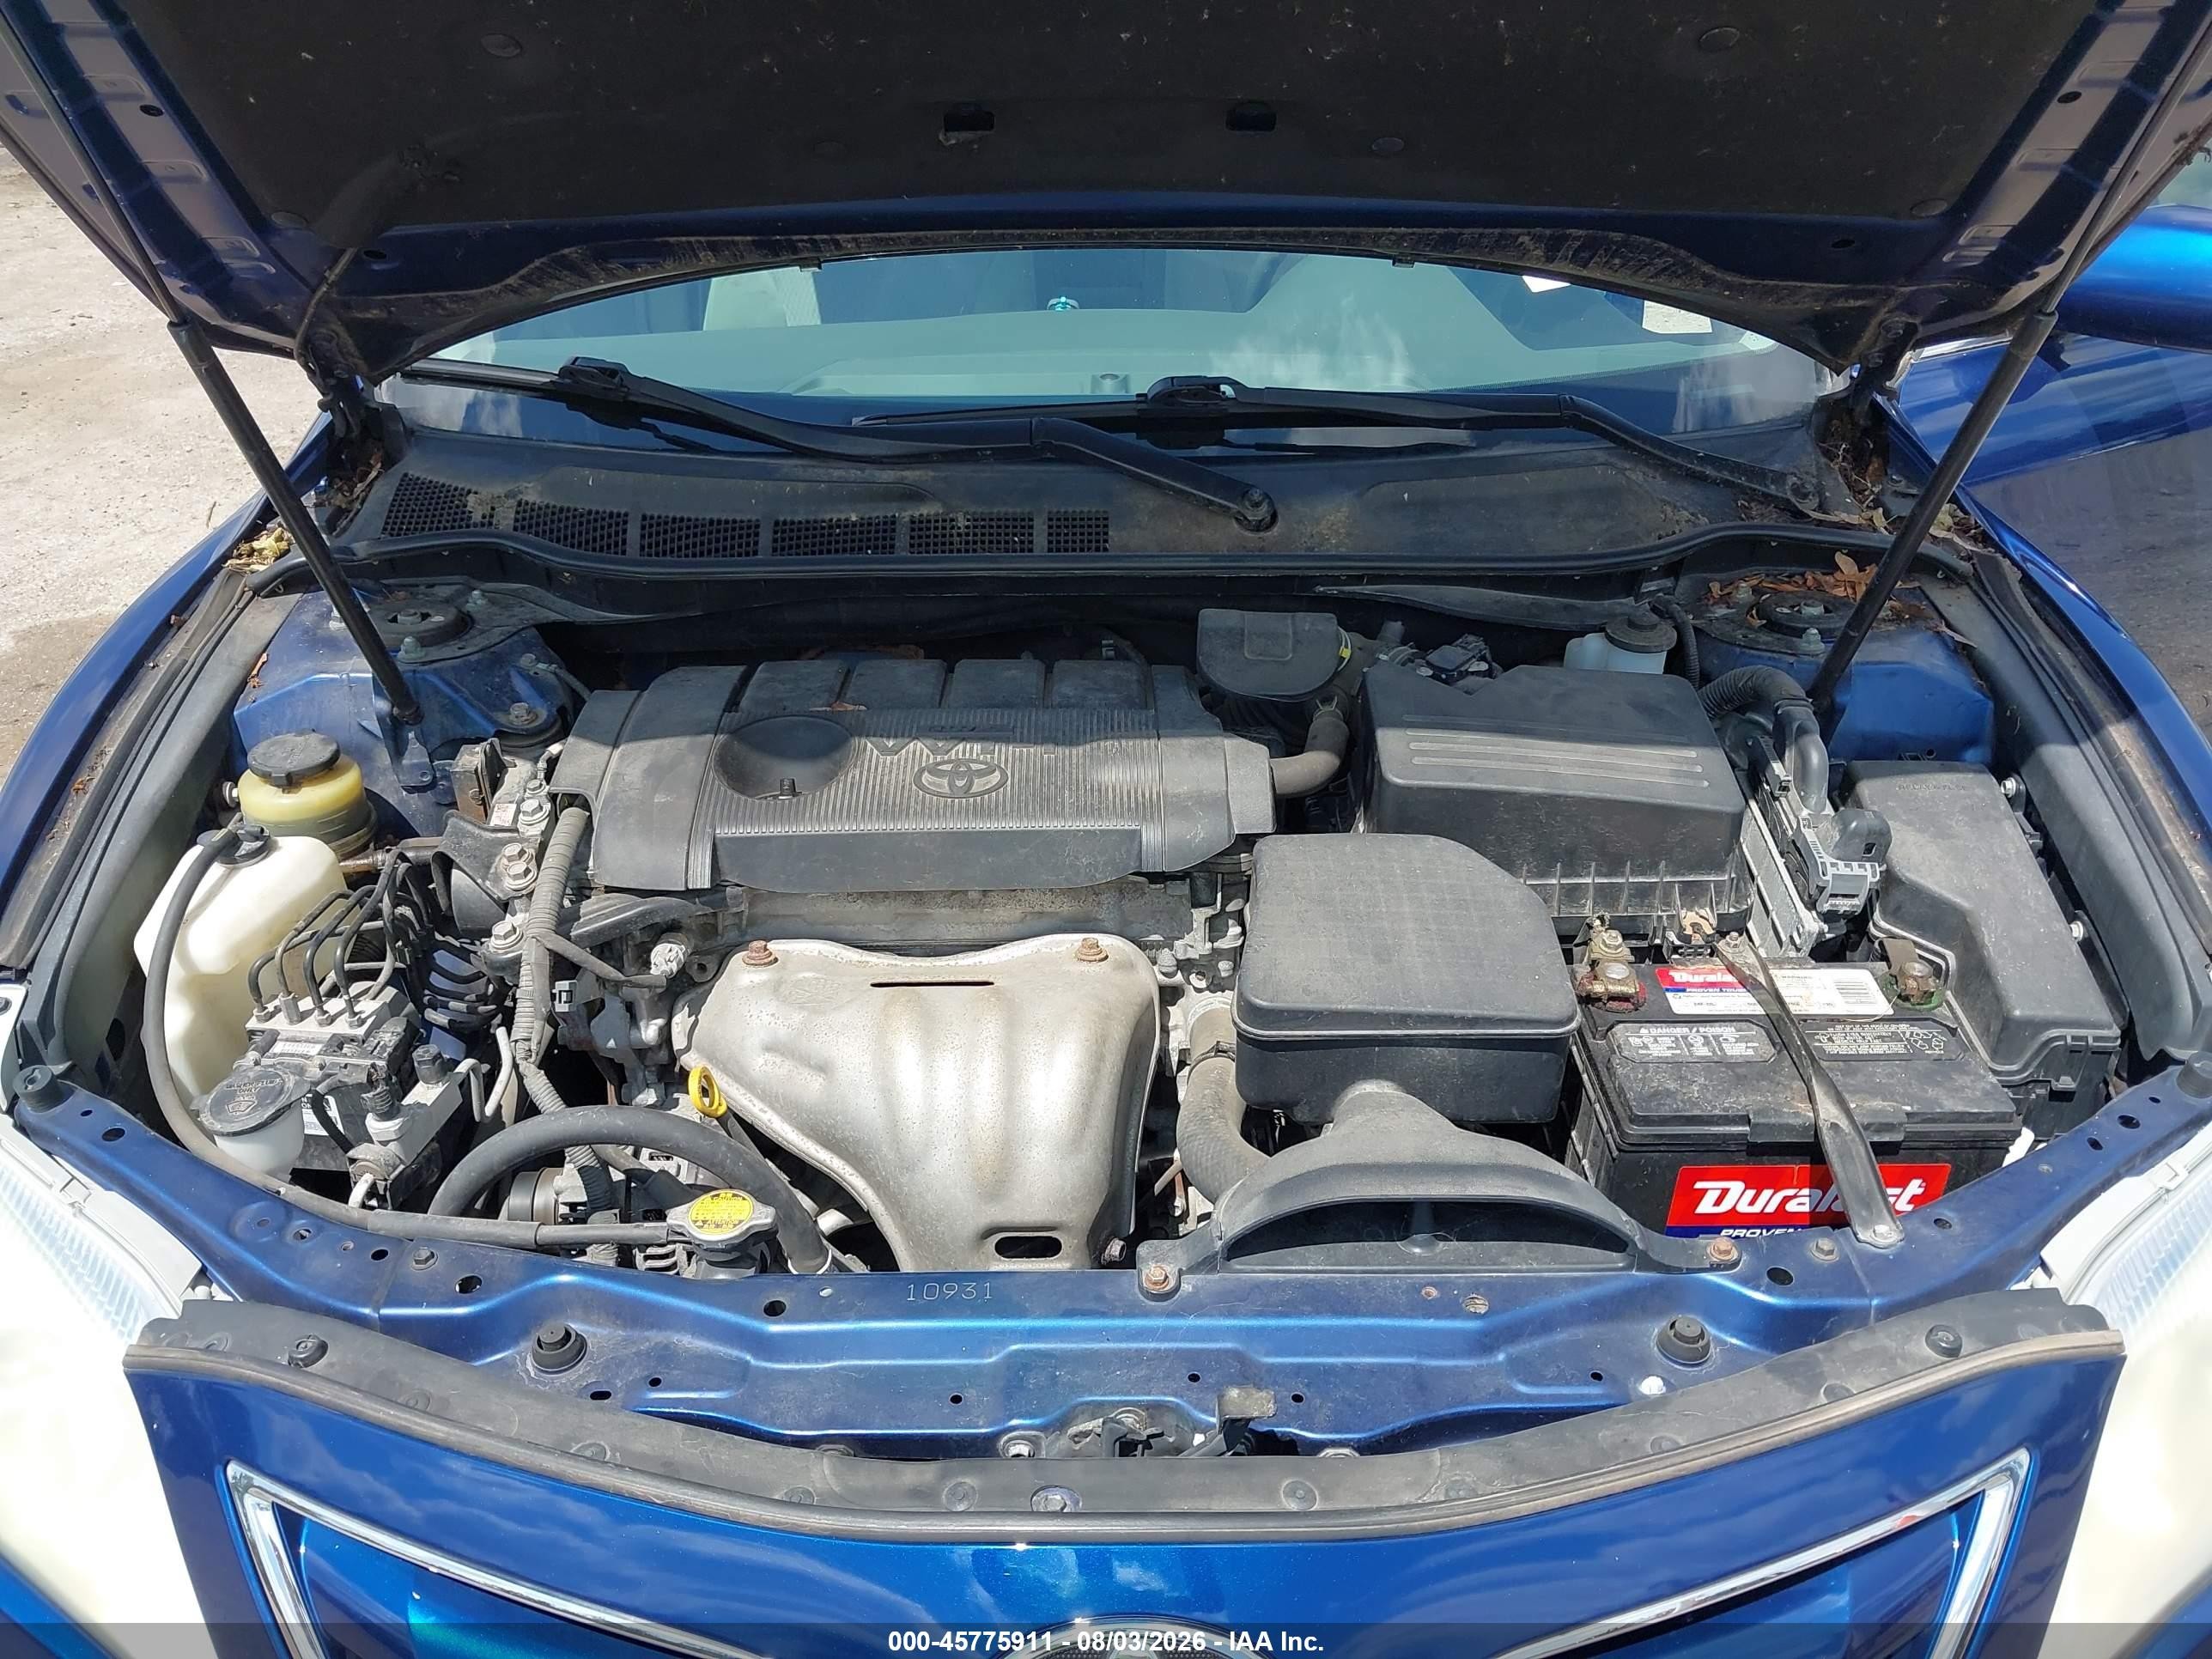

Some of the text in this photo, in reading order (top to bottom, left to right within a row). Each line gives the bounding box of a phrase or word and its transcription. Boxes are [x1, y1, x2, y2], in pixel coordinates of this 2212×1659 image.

[1668, 970, 1738, 983] Durala
[1693, 1178, 1925, 1214] Duralt
[907, 1282, 993, 1301] 10931
